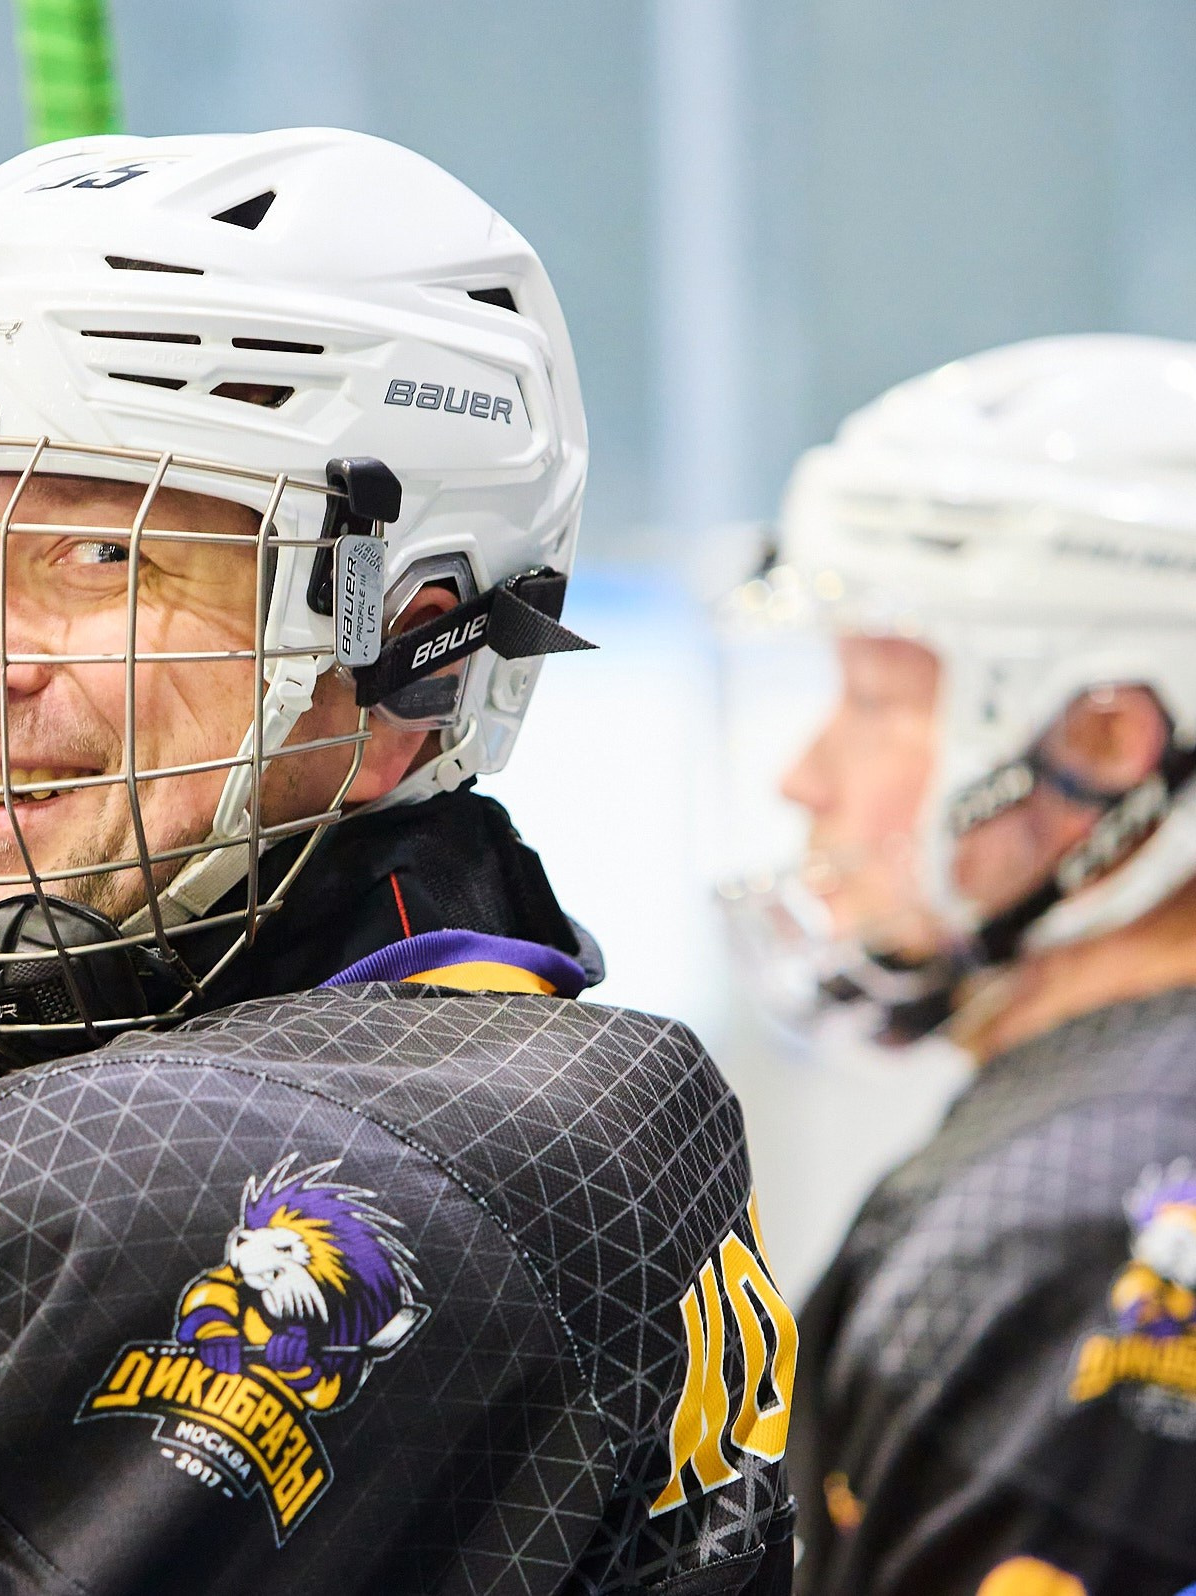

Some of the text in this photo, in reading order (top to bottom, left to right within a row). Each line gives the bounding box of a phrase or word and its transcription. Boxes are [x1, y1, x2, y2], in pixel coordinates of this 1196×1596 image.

[356, 588, 366, 643] PROFILE
[92, 1350, 324, 1526] ДИКОБРАЗЫ
[175, 1421, 252, 1480] МОСКВА
